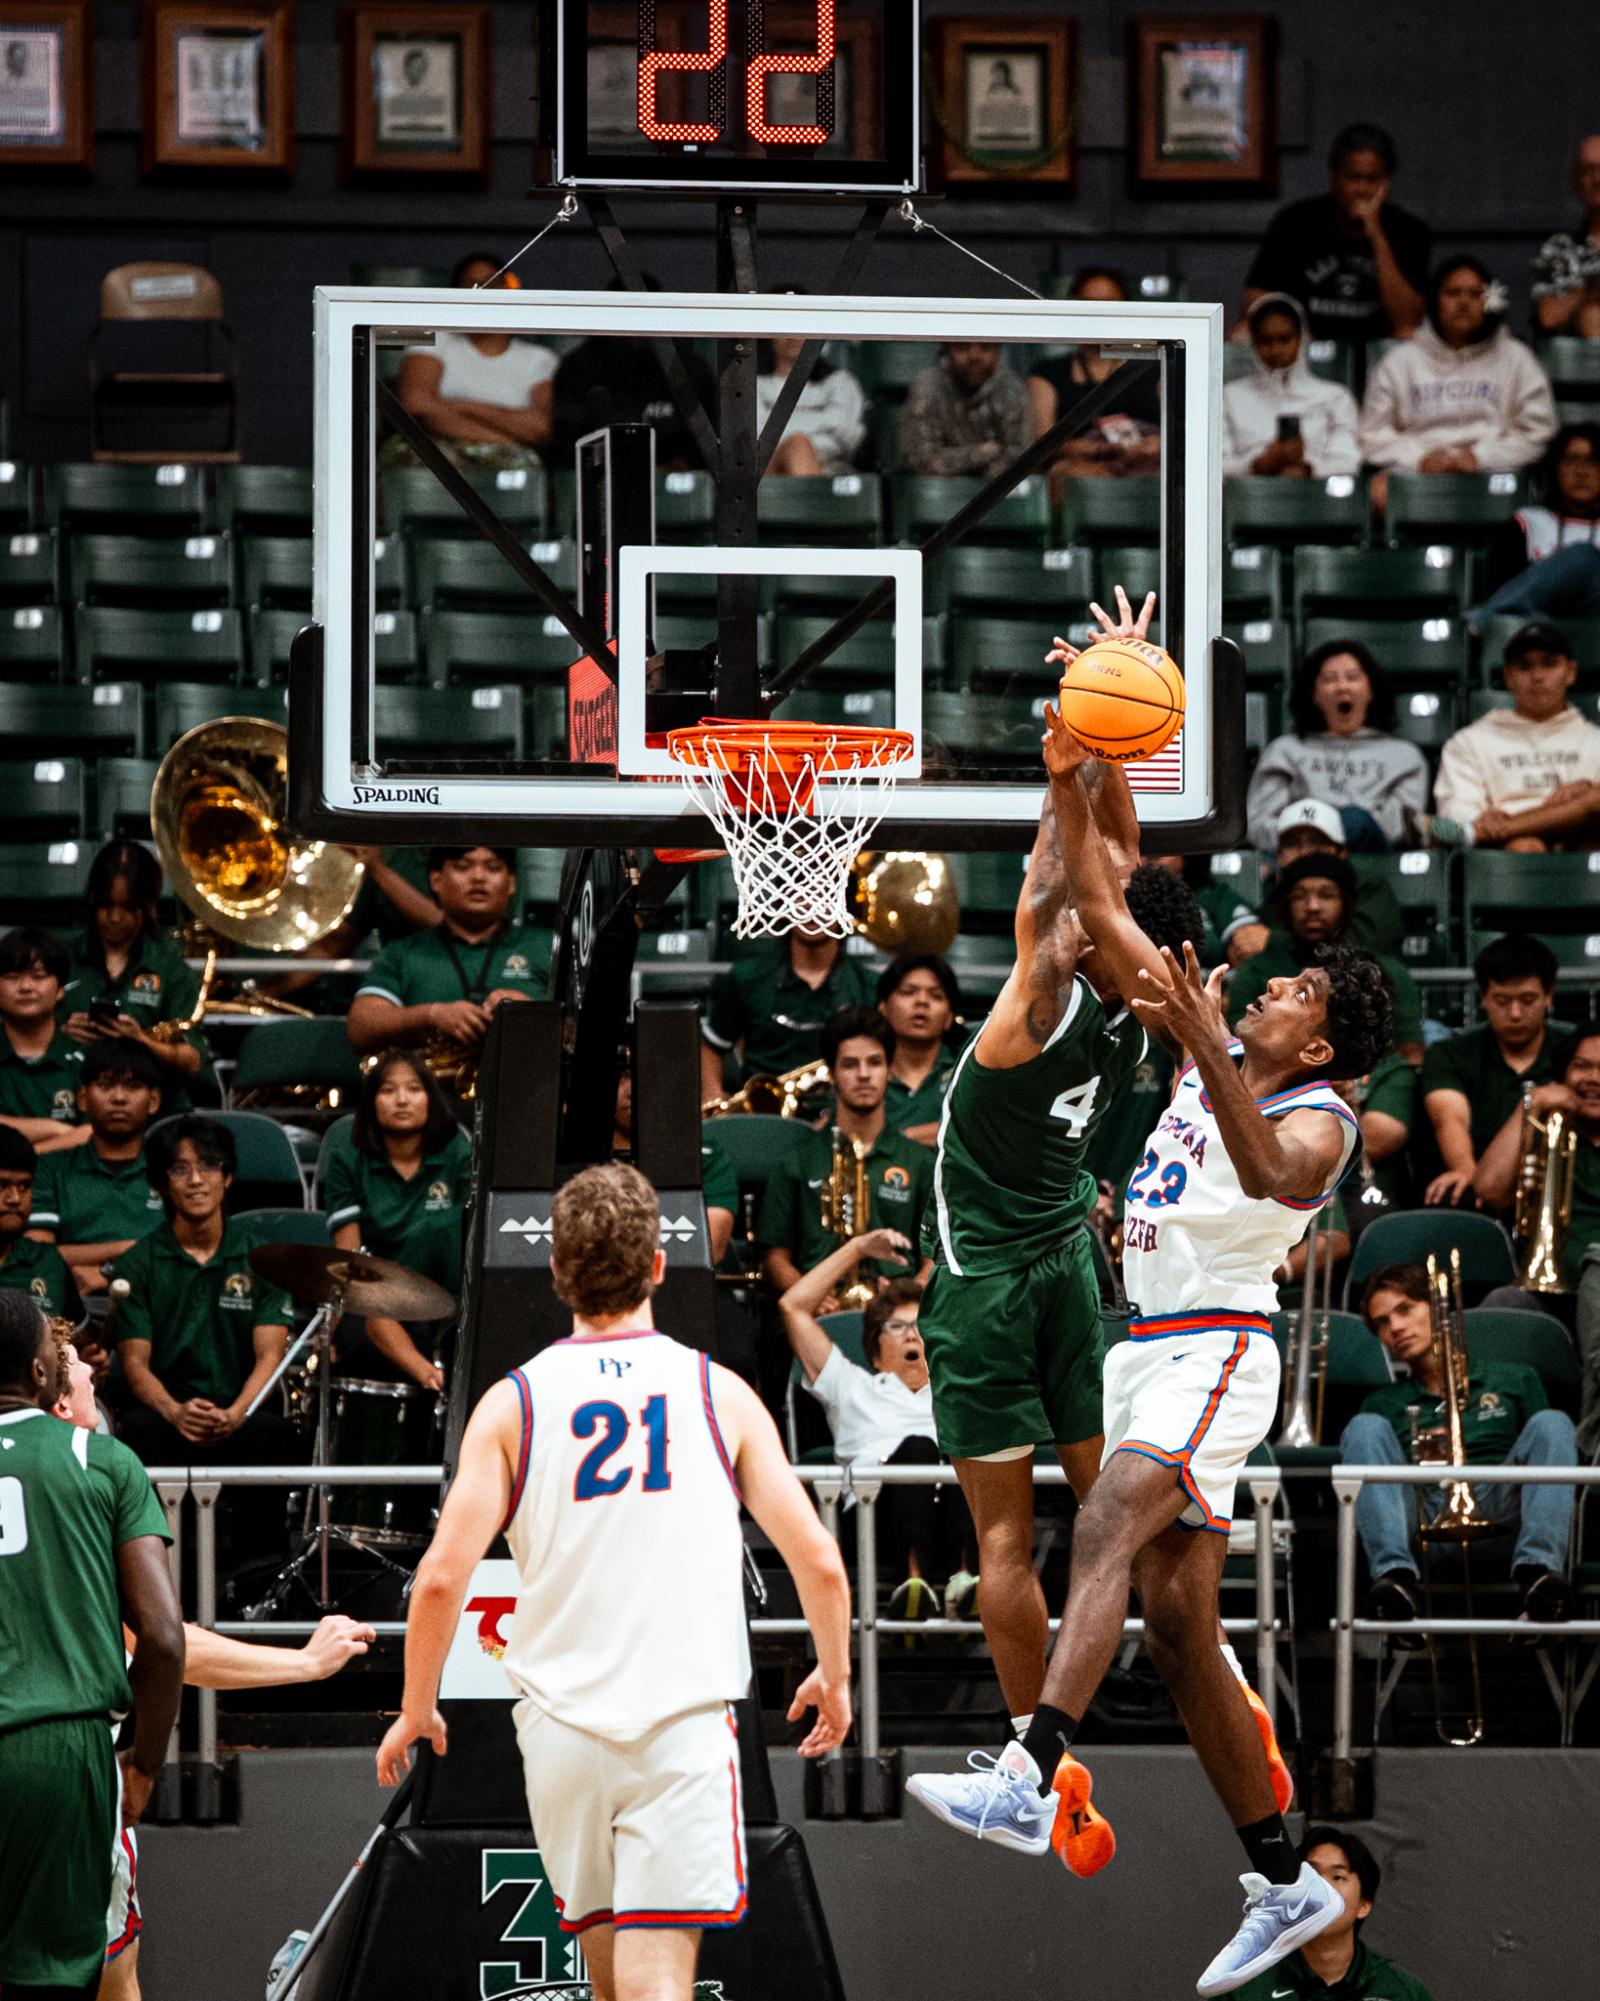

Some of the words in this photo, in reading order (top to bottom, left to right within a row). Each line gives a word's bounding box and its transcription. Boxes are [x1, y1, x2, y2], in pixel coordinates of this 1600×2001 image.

[353, 786, 439, 805] SPALDING
[1049, 1075, 1101, 1138] 4
[1126, 1147, 1187, 1208] 23
[571, 1394, 671, 1503] 21
